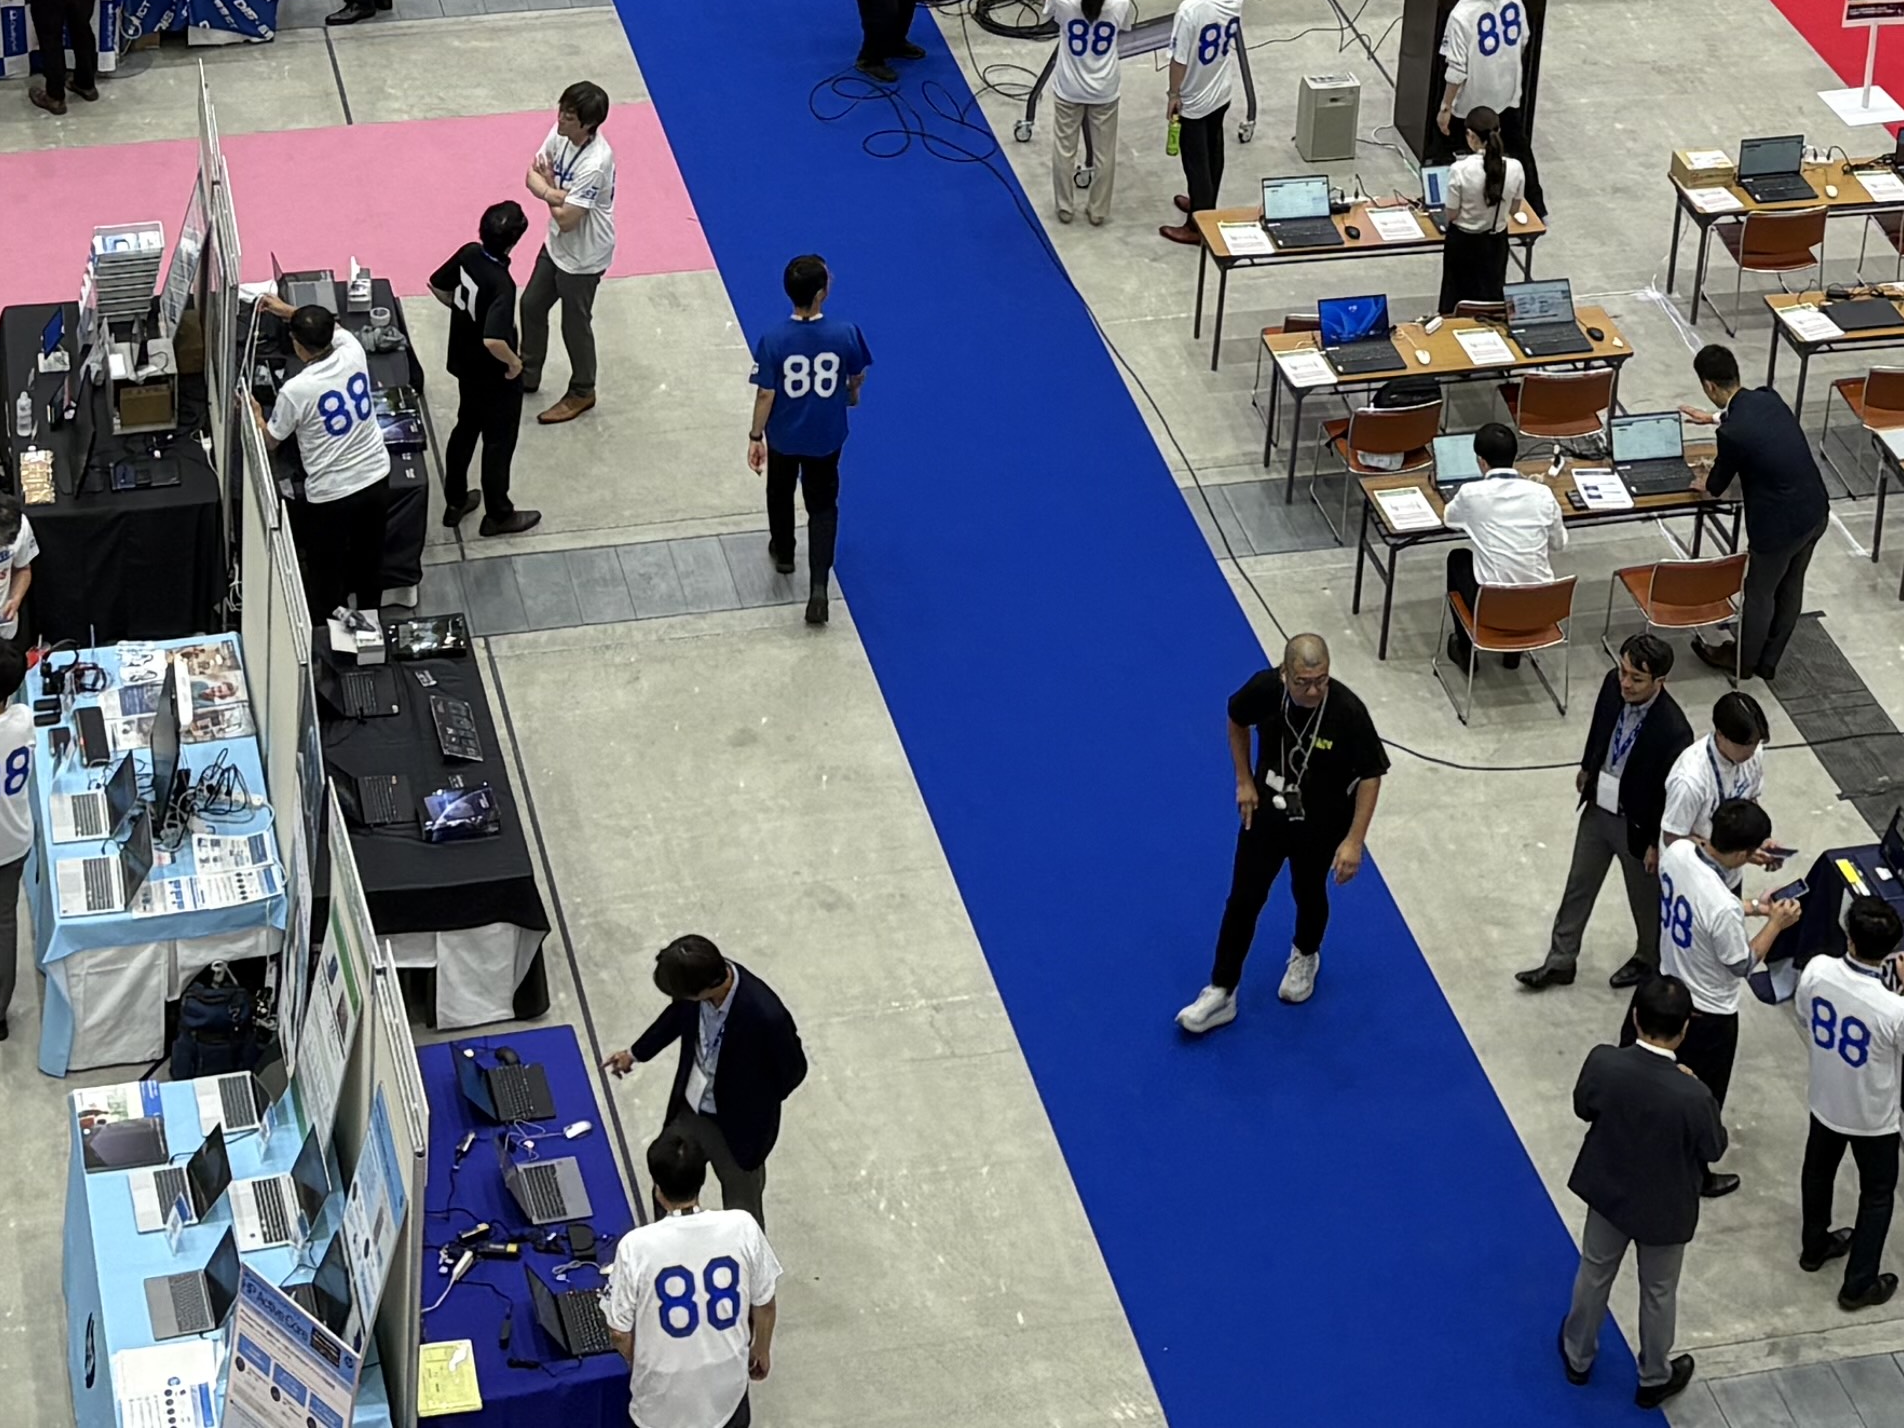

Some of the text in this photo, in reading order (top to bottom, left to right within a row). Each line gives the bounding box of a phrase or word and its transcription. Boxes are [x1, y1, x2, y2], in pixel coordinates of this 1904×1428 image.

[1066, 18, 1114, 56] 88
[1476, 1, 1523, 57] 88
[316, 372, 373, 437] 88
[783, 351, 839, 399] 88
[1809, 995, 1873, 1069] 88
[655, 1255, 742, 1339] 88
